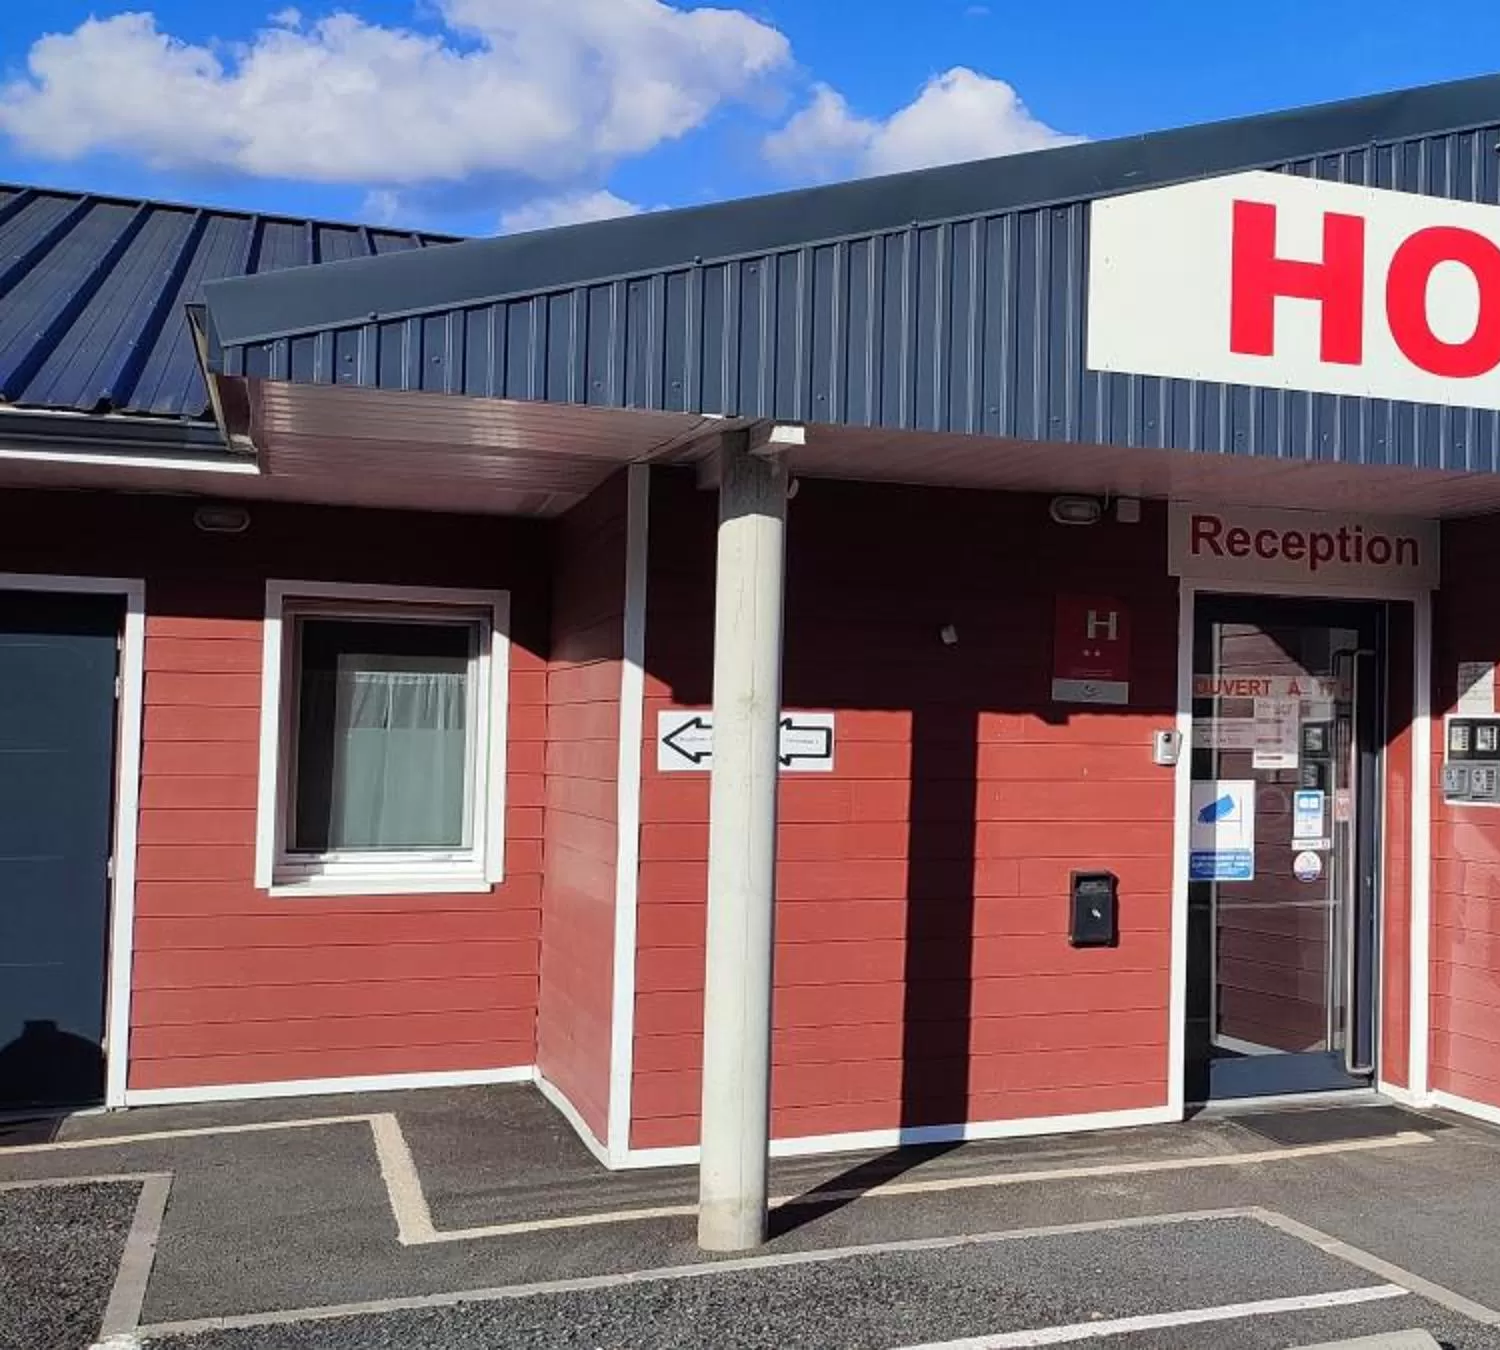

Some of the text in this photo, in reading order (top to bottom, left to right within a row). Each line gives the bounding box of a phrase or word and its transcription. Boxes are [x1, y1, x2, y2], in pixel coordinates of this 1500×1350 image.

[1191, 514, 1419, 570] Reception
[1087, 609, 1117, 640] H
[1194, 679, 1273, 697] OUVERT
